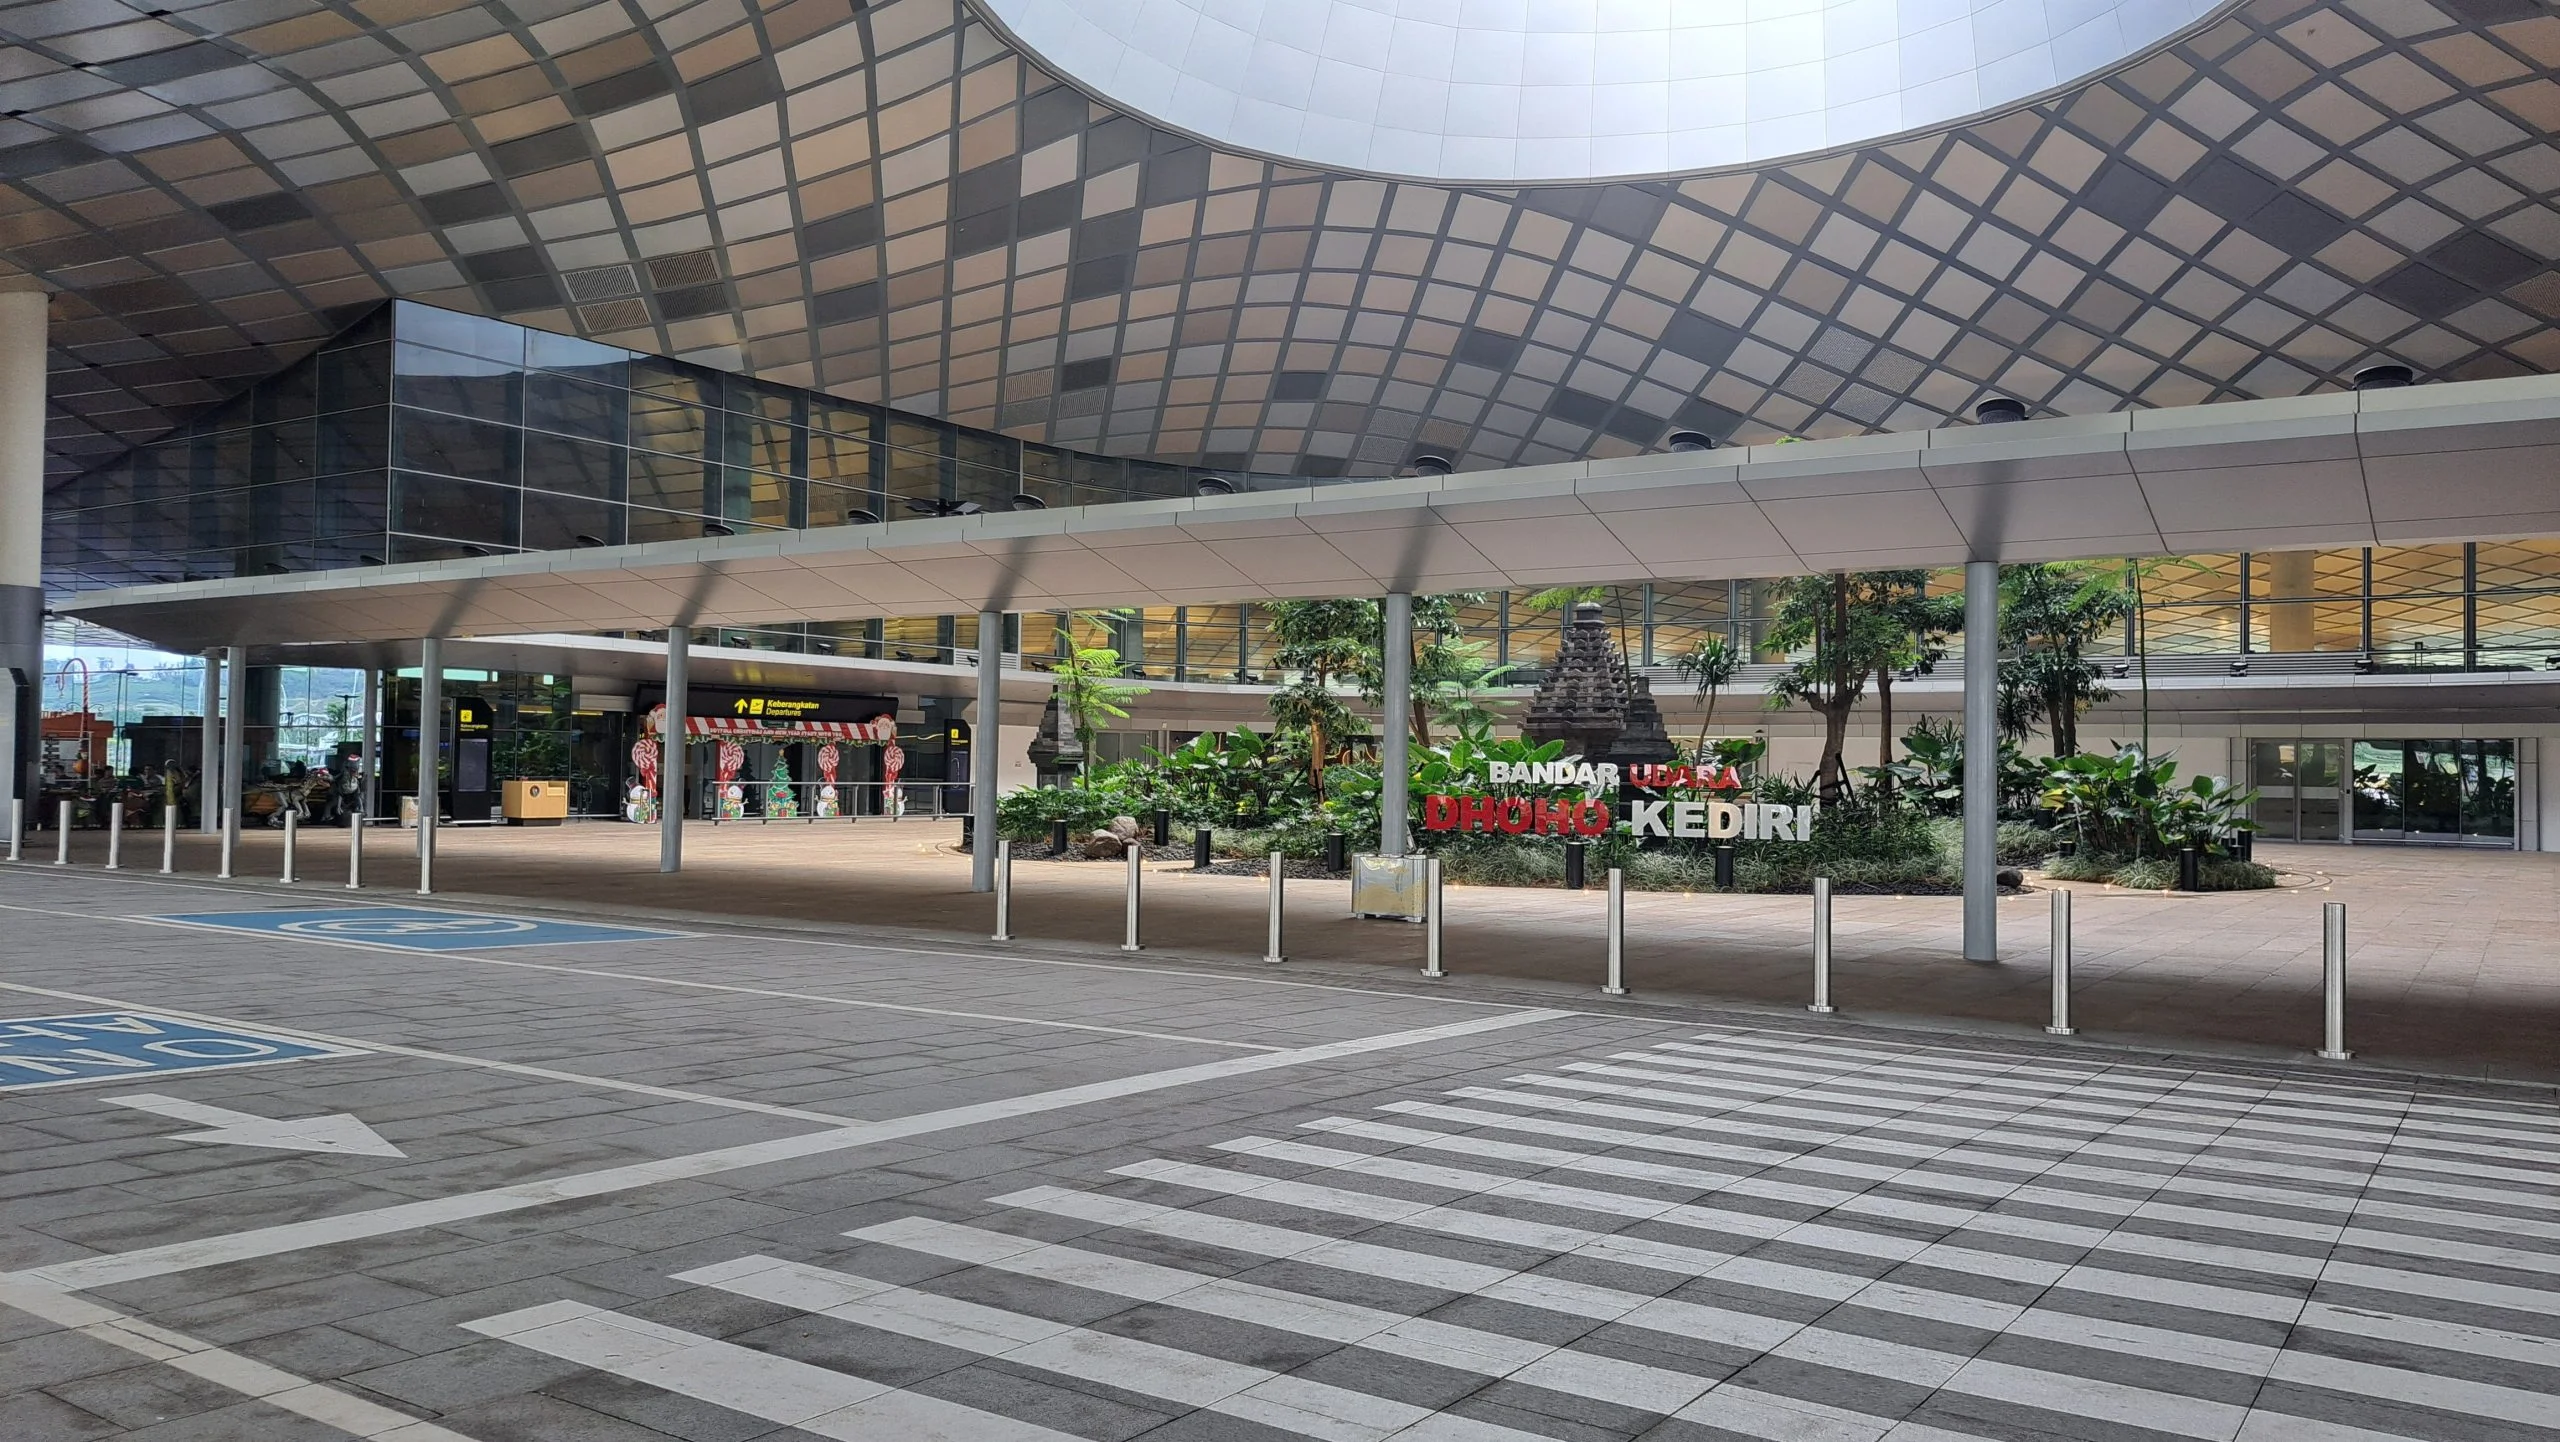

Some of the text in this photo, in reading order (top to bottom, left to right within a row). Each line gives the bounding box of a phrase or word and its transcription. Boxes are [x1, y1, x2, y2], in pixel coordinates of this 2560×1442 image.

[766, 708, 802, 717] Departures
[767, 699, 820, 710] Keberangkatan
[1489, 761, 1742, 789] BANDAR UDARA
[1425, 795, 1811, 841] DHOHO KEDIRI
